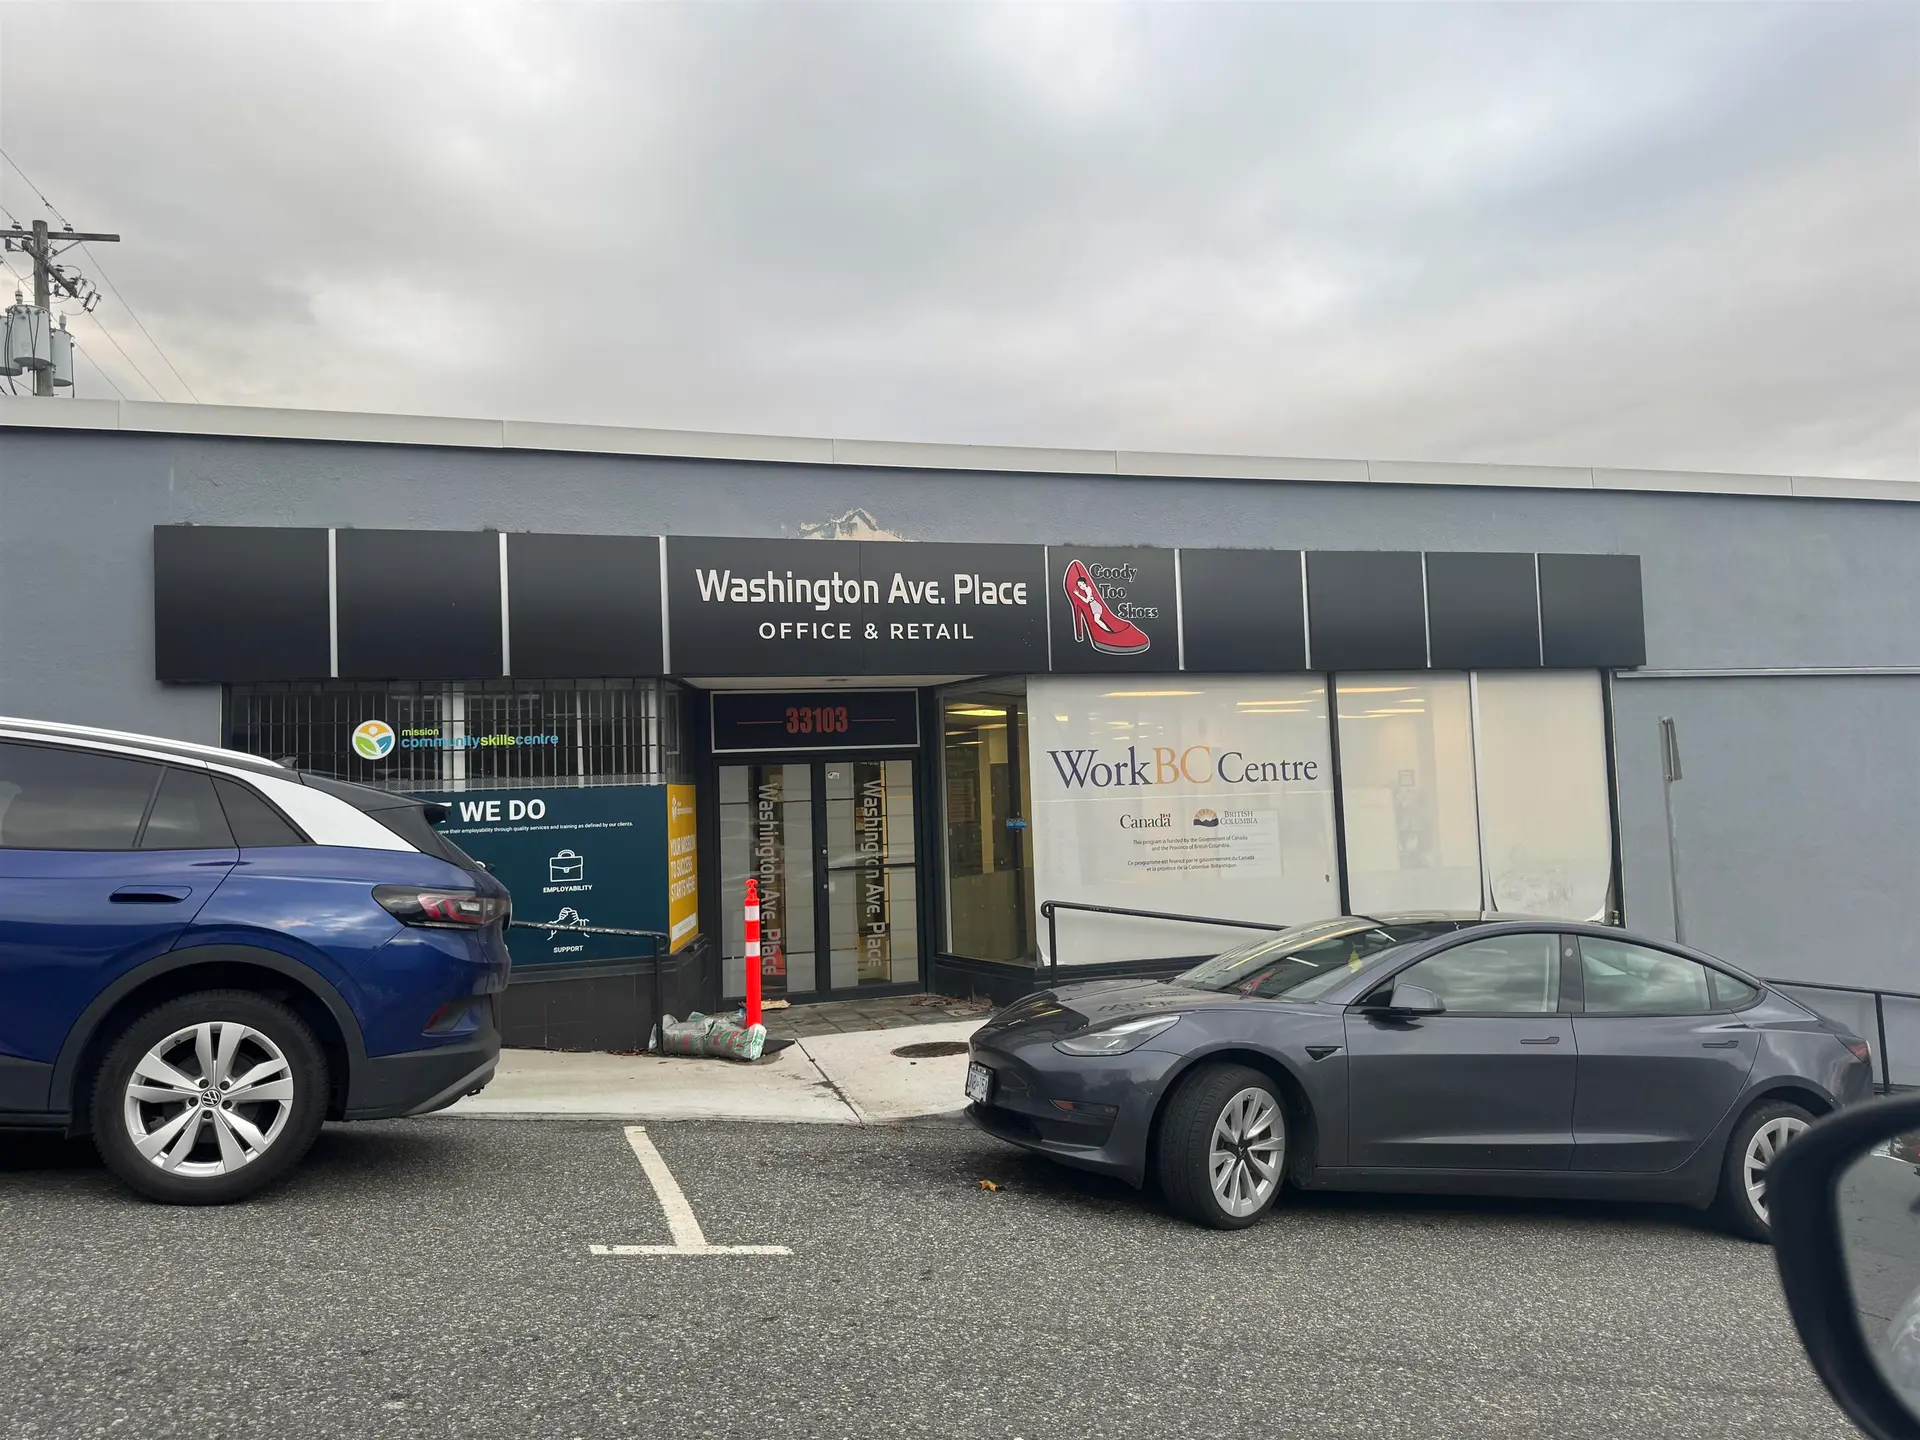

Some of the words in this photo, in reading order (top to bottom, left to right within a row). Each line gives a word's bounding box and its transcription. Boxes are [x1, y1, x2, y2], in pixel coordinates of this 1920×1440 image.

[1089, 563, 1138, 583] Goody
[695, 568, 880, 611] Washington
[888, 573, 946, 605] Ave.
[954, 573, 1028, 606] Place
[1099, 583, 1127, 599] Too
[758, 622, 853, 641] OFFICE
[864, 622, 879, 641] &
[890, 622, 974, 641] RETAIL
[401, 727, 439, 737] mission
[786, 706, 848, 734] 33103
[1217, 751, 1319, 784] Centre
[459, 800, 502, 823] WE
[509, 798, 546, 821] DO
[1120, 813, 1171, 829] Canada
[461, 827, 493, 835] employability
[494, 826, 512, 834] through
[513, 825, 529, 833] quality
[755, 782, 780, 885] Washington
[860, 779, 882, 879] Washington
[543, 884, 593, 894] EMPLOYABILITY
[865, 883, 885, 918] Ave.
[760, 888, 781, 925] Ave.
[553, 945, 584, 954] SUPPORT
[761, 927, 782, 976] Place
[866, 921, 886, 968] Place
